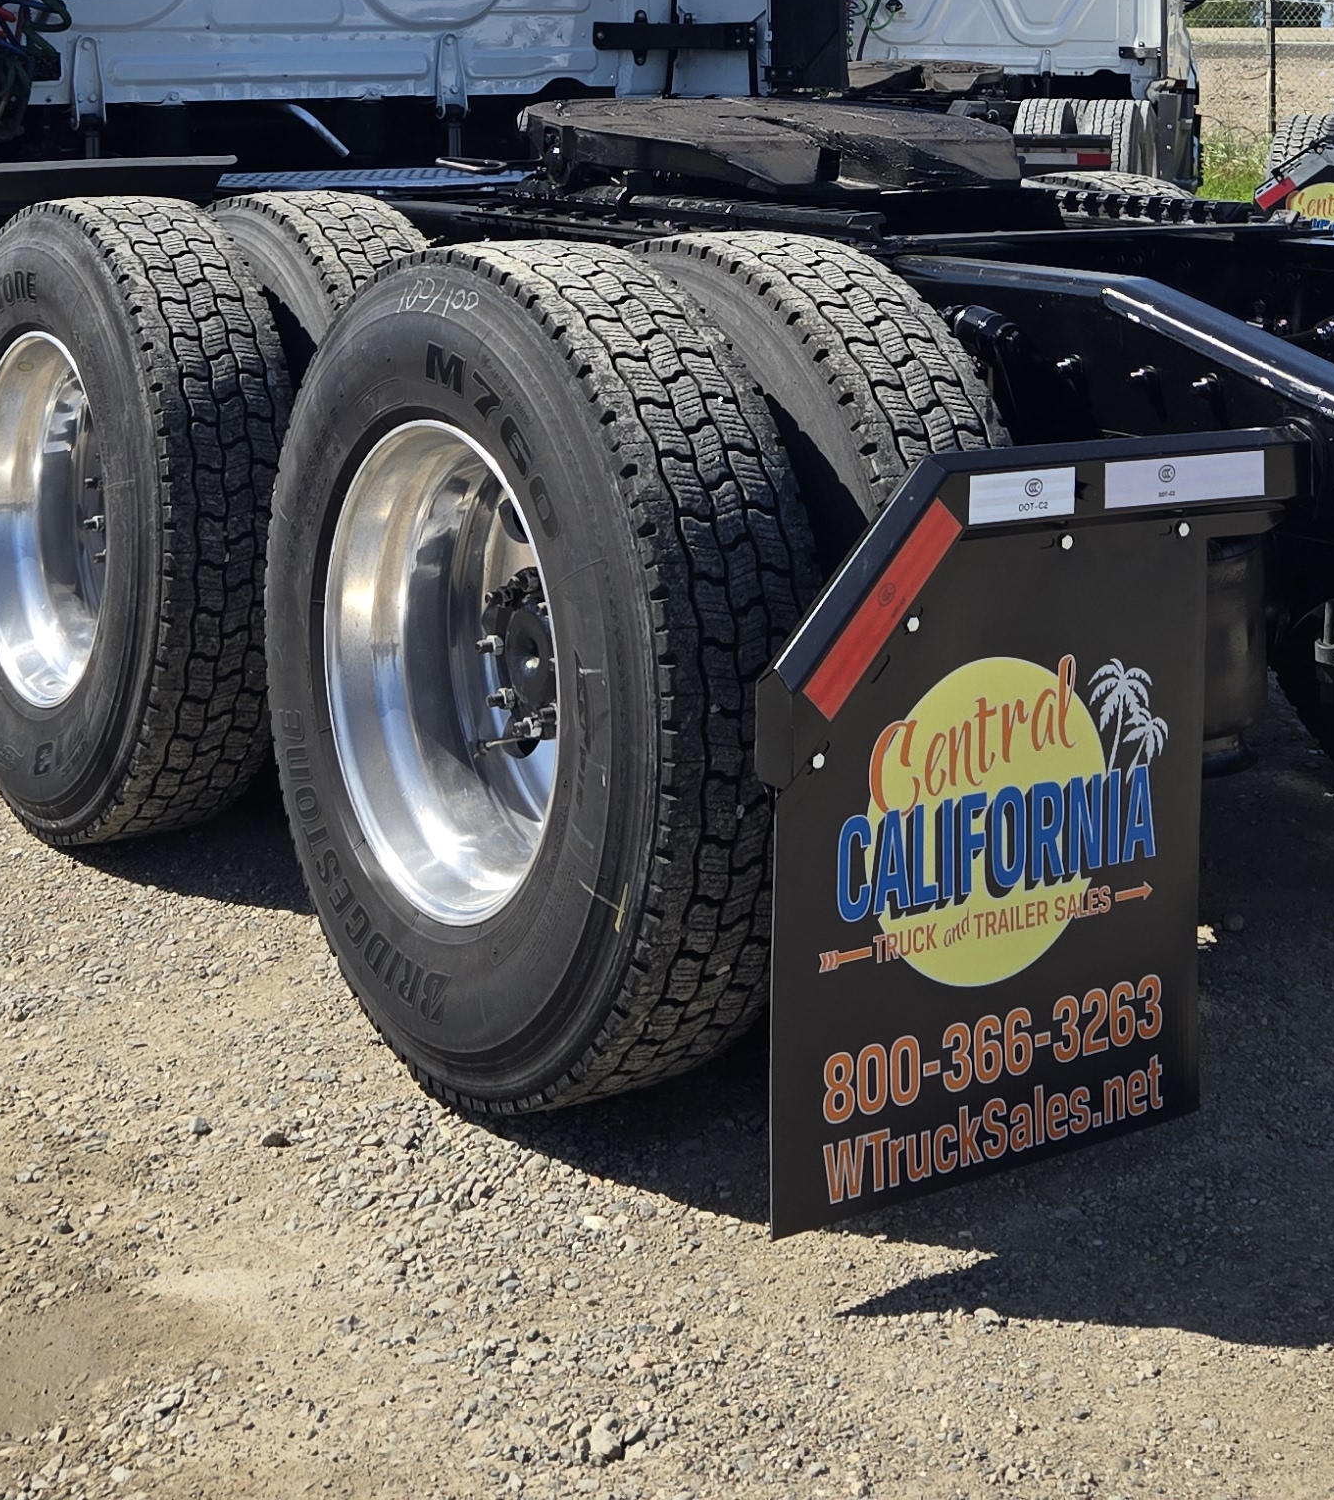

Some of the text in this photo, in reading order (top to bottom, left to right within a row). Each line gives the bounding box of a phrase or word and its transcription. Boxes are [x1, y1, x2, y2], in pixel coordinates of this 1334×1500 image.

[396, 277, 479, 317] 100/100
[425, 340, 561, 541] M760
[1019, 501, 1049, 512] DOT-C2
[870, 654, 1077, 816] Central
[278, 708, 452, 1026] BRIDGESTONE
[836, 764, 1157, 923] CALIFORNIA
[873, 886, 1112, 965] TRUCK and TRAILER SALES
[823, 974, 1164, 1125] 800-366-3263
[823, 1054, 1165, 1204] WTruckSales.net
